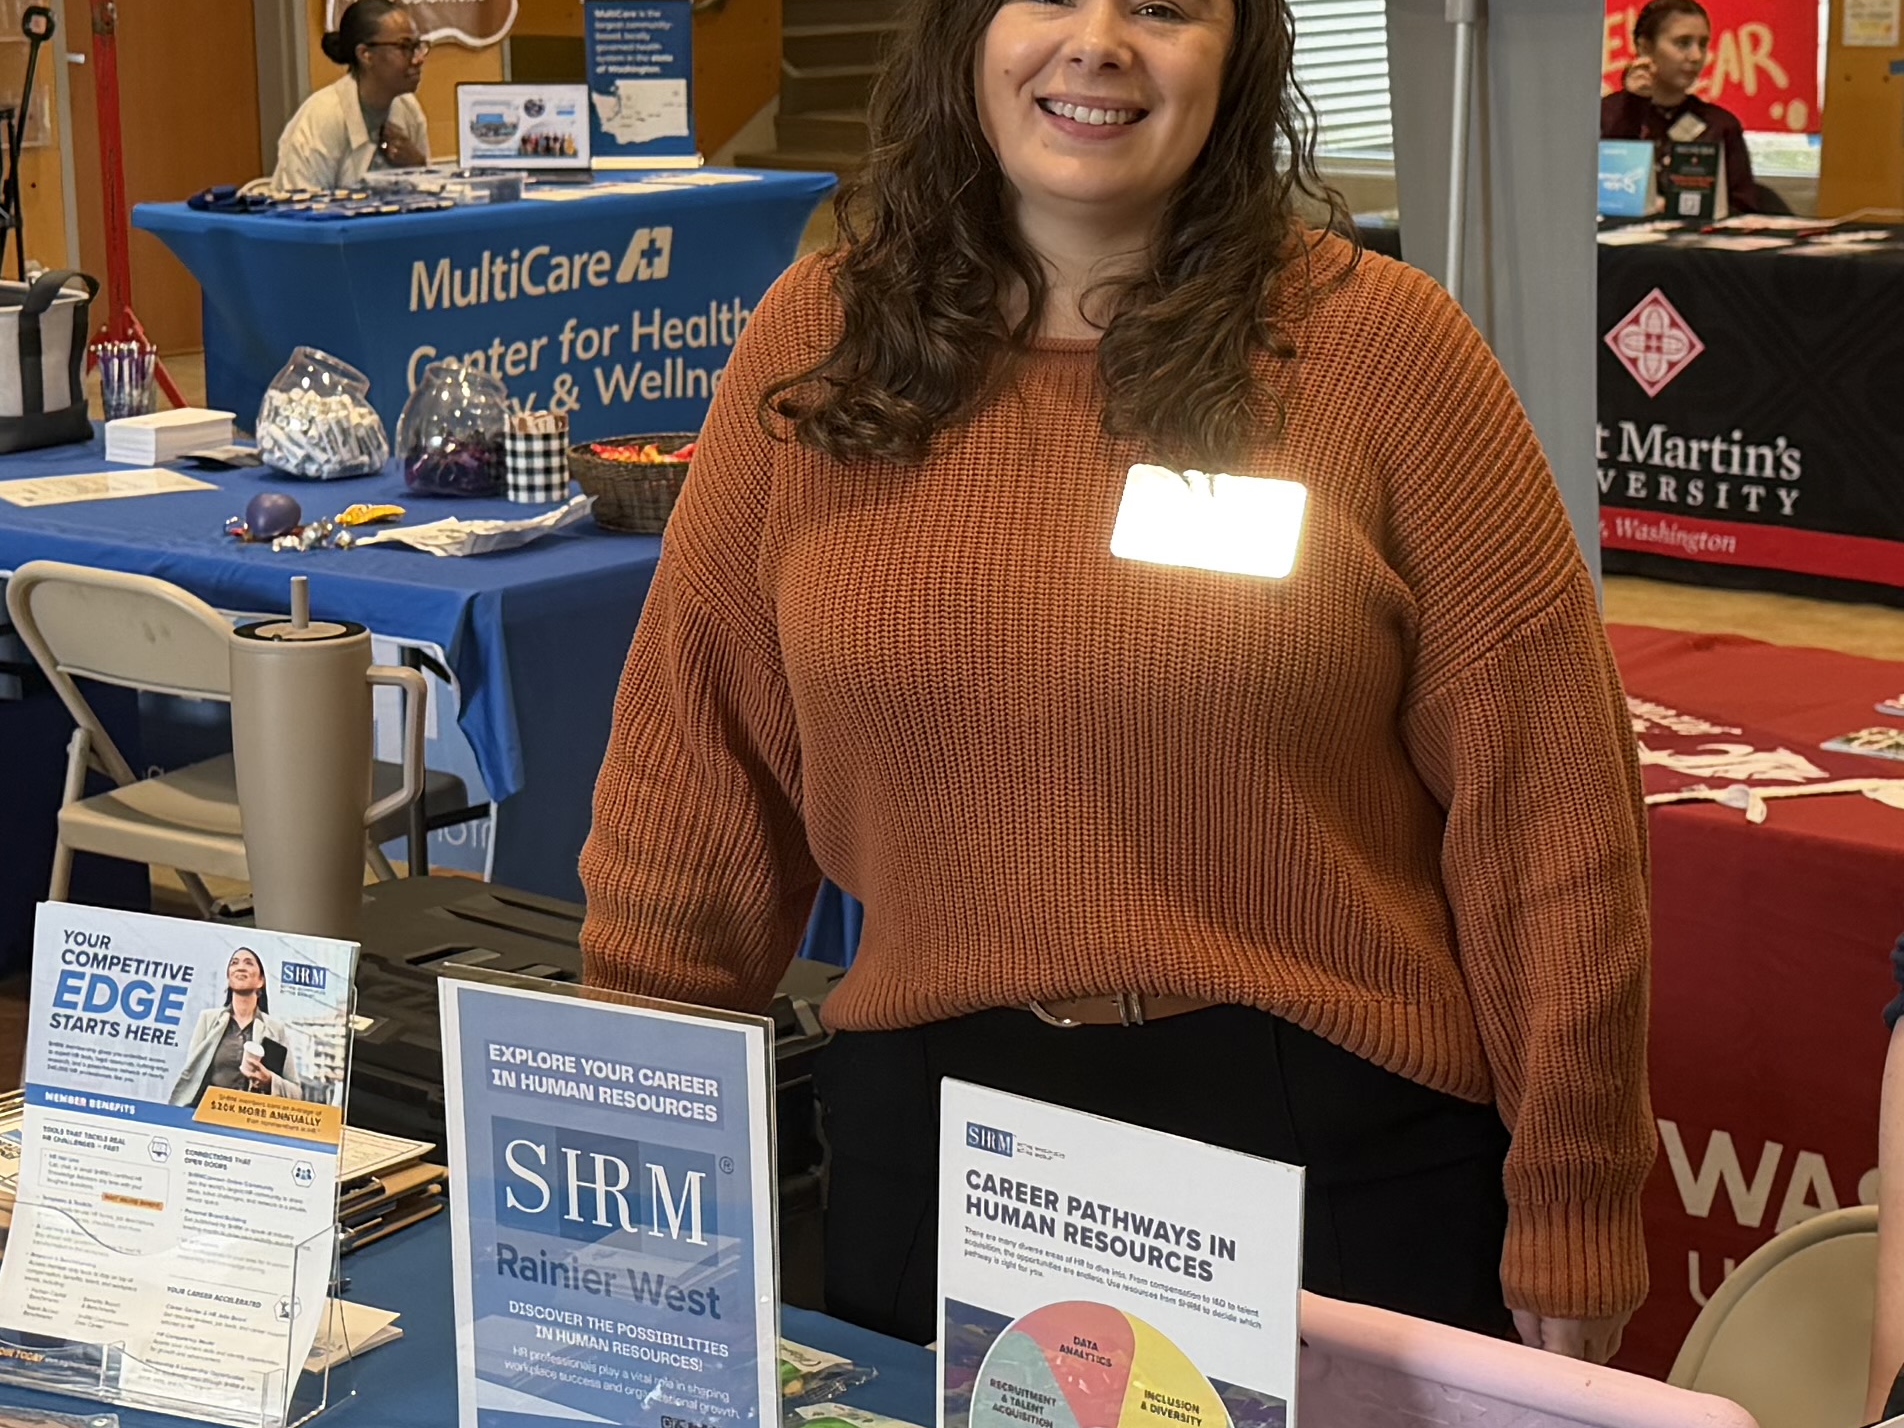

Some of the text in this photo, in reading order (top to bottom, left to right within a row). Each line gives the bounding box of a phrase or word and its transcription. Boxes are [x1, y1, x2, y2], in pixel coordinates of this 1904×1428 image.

[409, 244, 611, 312] MultiCare
[559, 296, 756, 365] for Health
[1617, 420, 1802, 481] Martin's
[1615, 516, 1737, 555] Washington
[64, 929, 111, 950] YOUR
[61, 948, 194, 983] COMPETITIVE
[53, 969, 188, 1026] EDGE
[49, 1013, 179, 1047] STARTS HERE.
[489, 1043, 719, 1098] EXPLORE YOUR CAREER
[492, 1069, 718, 1122] IN HUMAN RESOURCES
[968, 1126, 1011, 1155] SHRM
[505, 1139, 708, 1246] SHRM
[966, 1169, 1236, 1262] CAREER PATHWAYS IN
[966, 1194, 1213, 1282] HUMAN RESOURCES
[497, 1242, 721, 1320] Rainier West
[509, 1301, 729, 1357] DISCOVER THE POSSIBILITIES
[535, 1325, 609, 1353] IN HUMAN
[1073, 1336, 1099, 1352] DATA
[1059, 1344, 1112, 1368] ANALYTICS
[990, 1378, 1057, 1407] RECRUITMENT
[1010, 1395, 1044, 1414] TALENT
[1144, 1389, 1200, 1414] INCLUSION
[1150, 1403, 1202, 1427] DIVERSITY
